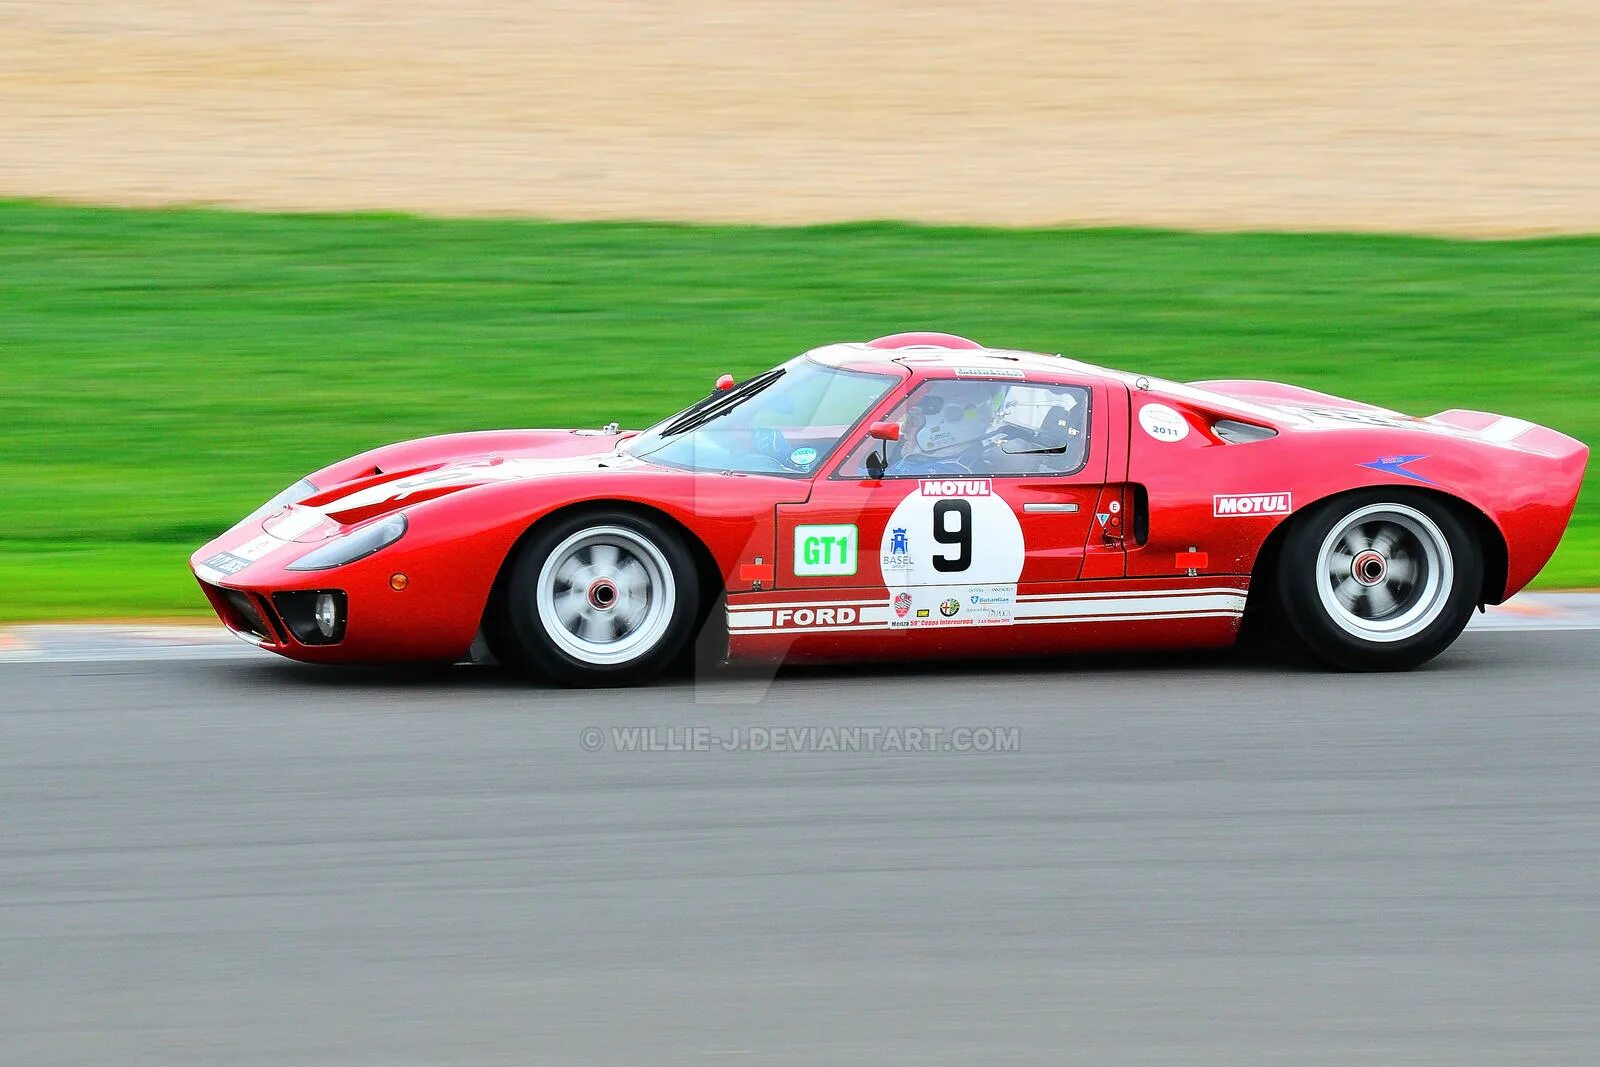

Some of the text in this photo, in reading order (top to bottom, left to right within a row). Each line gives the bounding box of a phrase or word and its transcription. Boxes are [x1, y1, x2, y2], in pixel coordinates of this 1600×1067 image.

[1153, 426, 1178, 436] 2011
[923, 480, 990, 496] MOTUL
[1112, 503, 1118, 511] E
[1217, 495, 1288, 514] MOTUL
[933, 498, 972, 572] 9
[803, 536, 848, 565] GT1
[883, 555, 914, 565] BASEL
[776, 607, 856, 627] FORD
